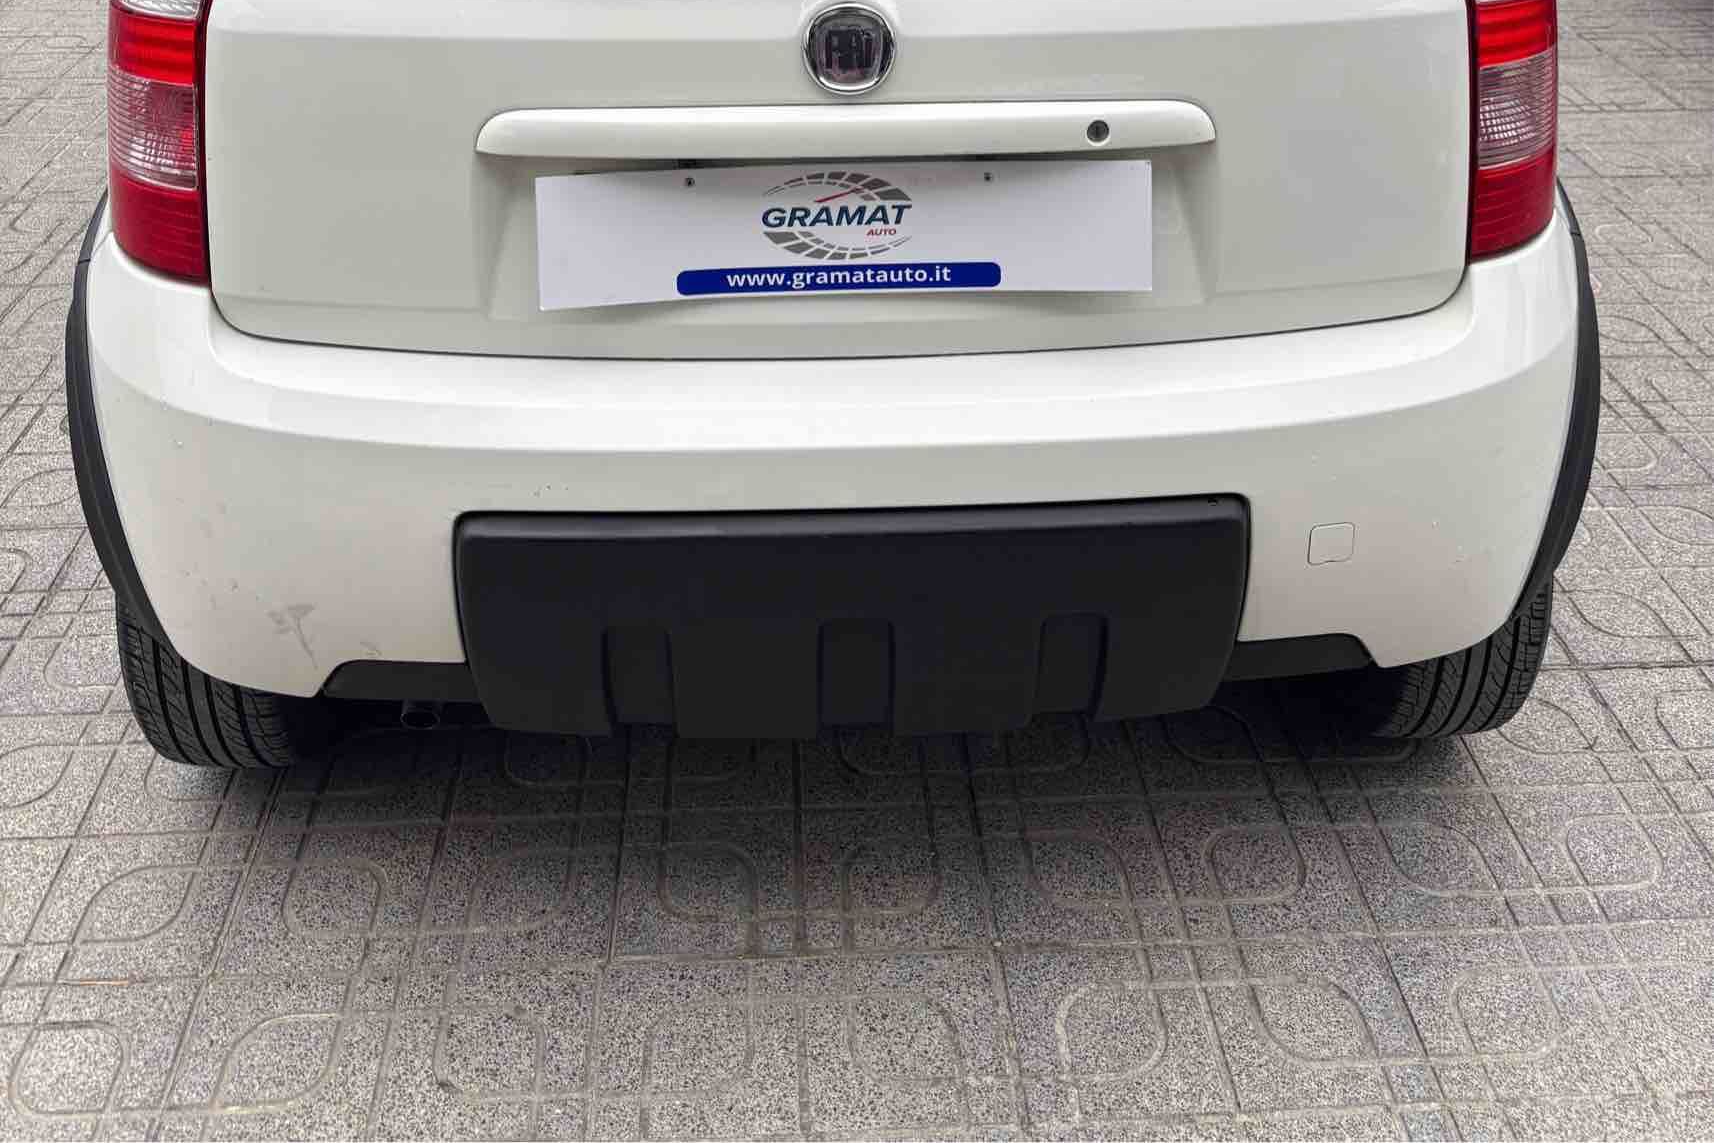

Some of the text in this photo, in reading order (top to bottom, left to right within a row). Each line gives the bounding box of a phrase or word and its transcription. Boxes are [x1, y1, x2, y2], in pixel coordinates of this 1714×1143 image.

[762, 204, 912, 228] GRAMAT
[866, 228, 897, 236] AUTO
[726, 265, 951, 289] www.gramatauto.it
